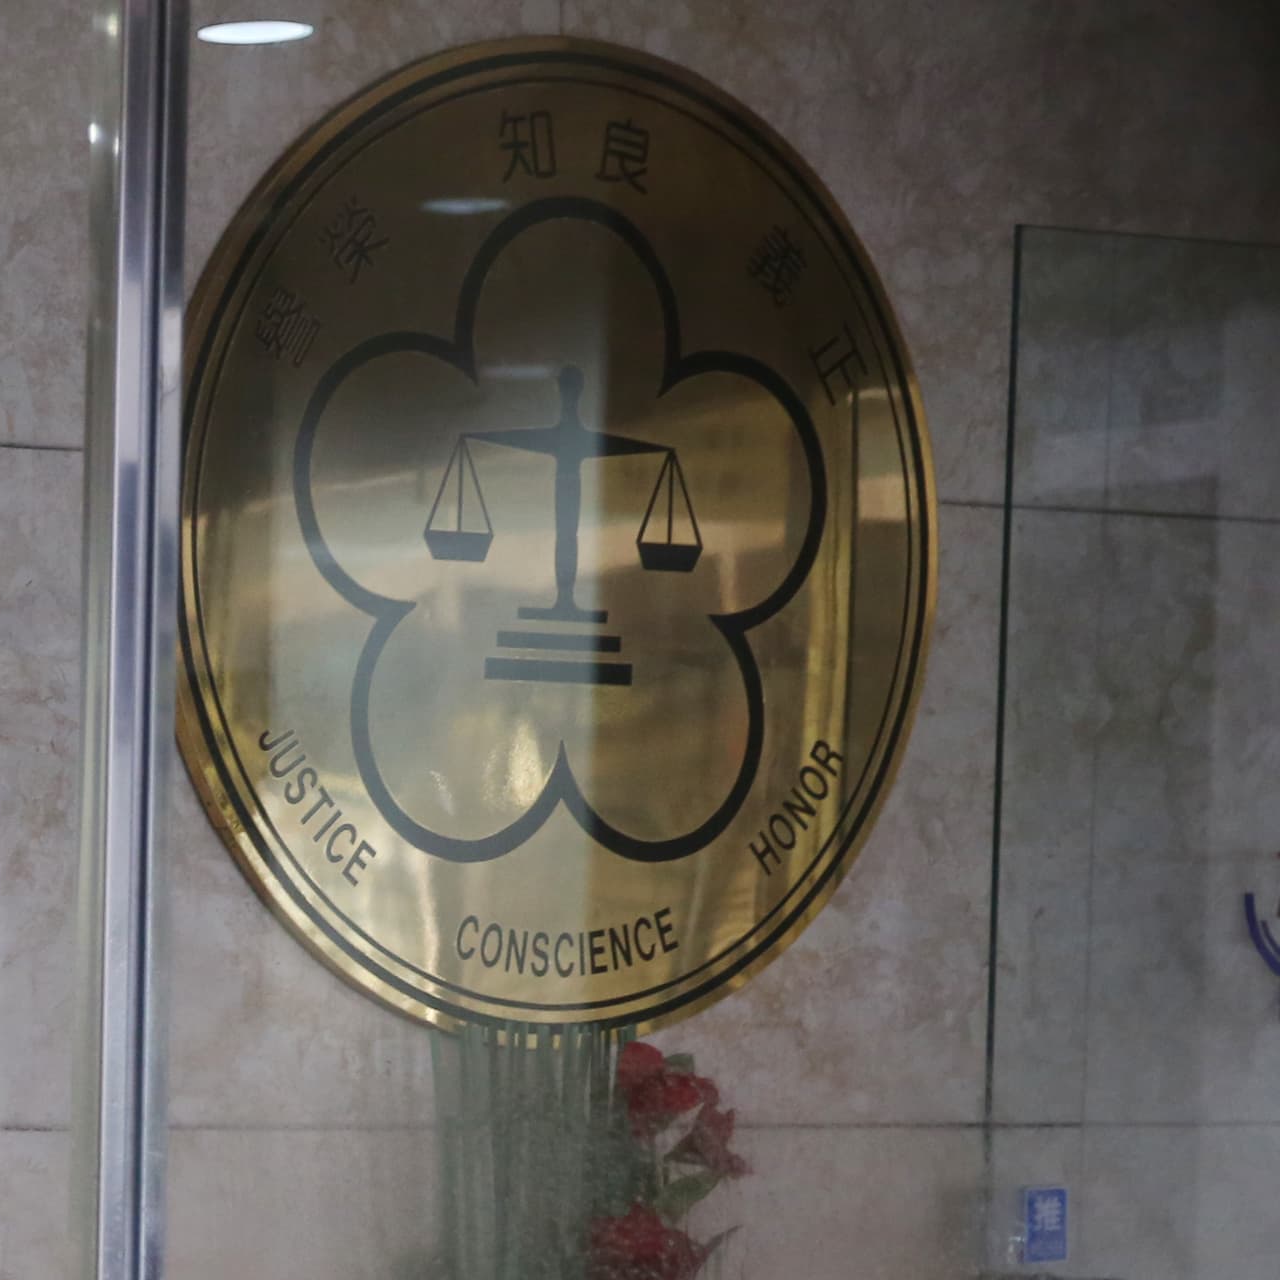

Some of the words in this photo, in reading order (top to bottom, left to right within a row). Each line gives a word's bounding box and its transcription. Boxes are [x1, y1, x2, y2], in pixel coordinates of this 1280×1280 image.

[258, 728, 377, 887] JUSTICE
[748, 739, 845, 876] HONOR
[455, 907, 680, 978] CONSCIENCE
[1033, 1195, 1062, 1232] 推
